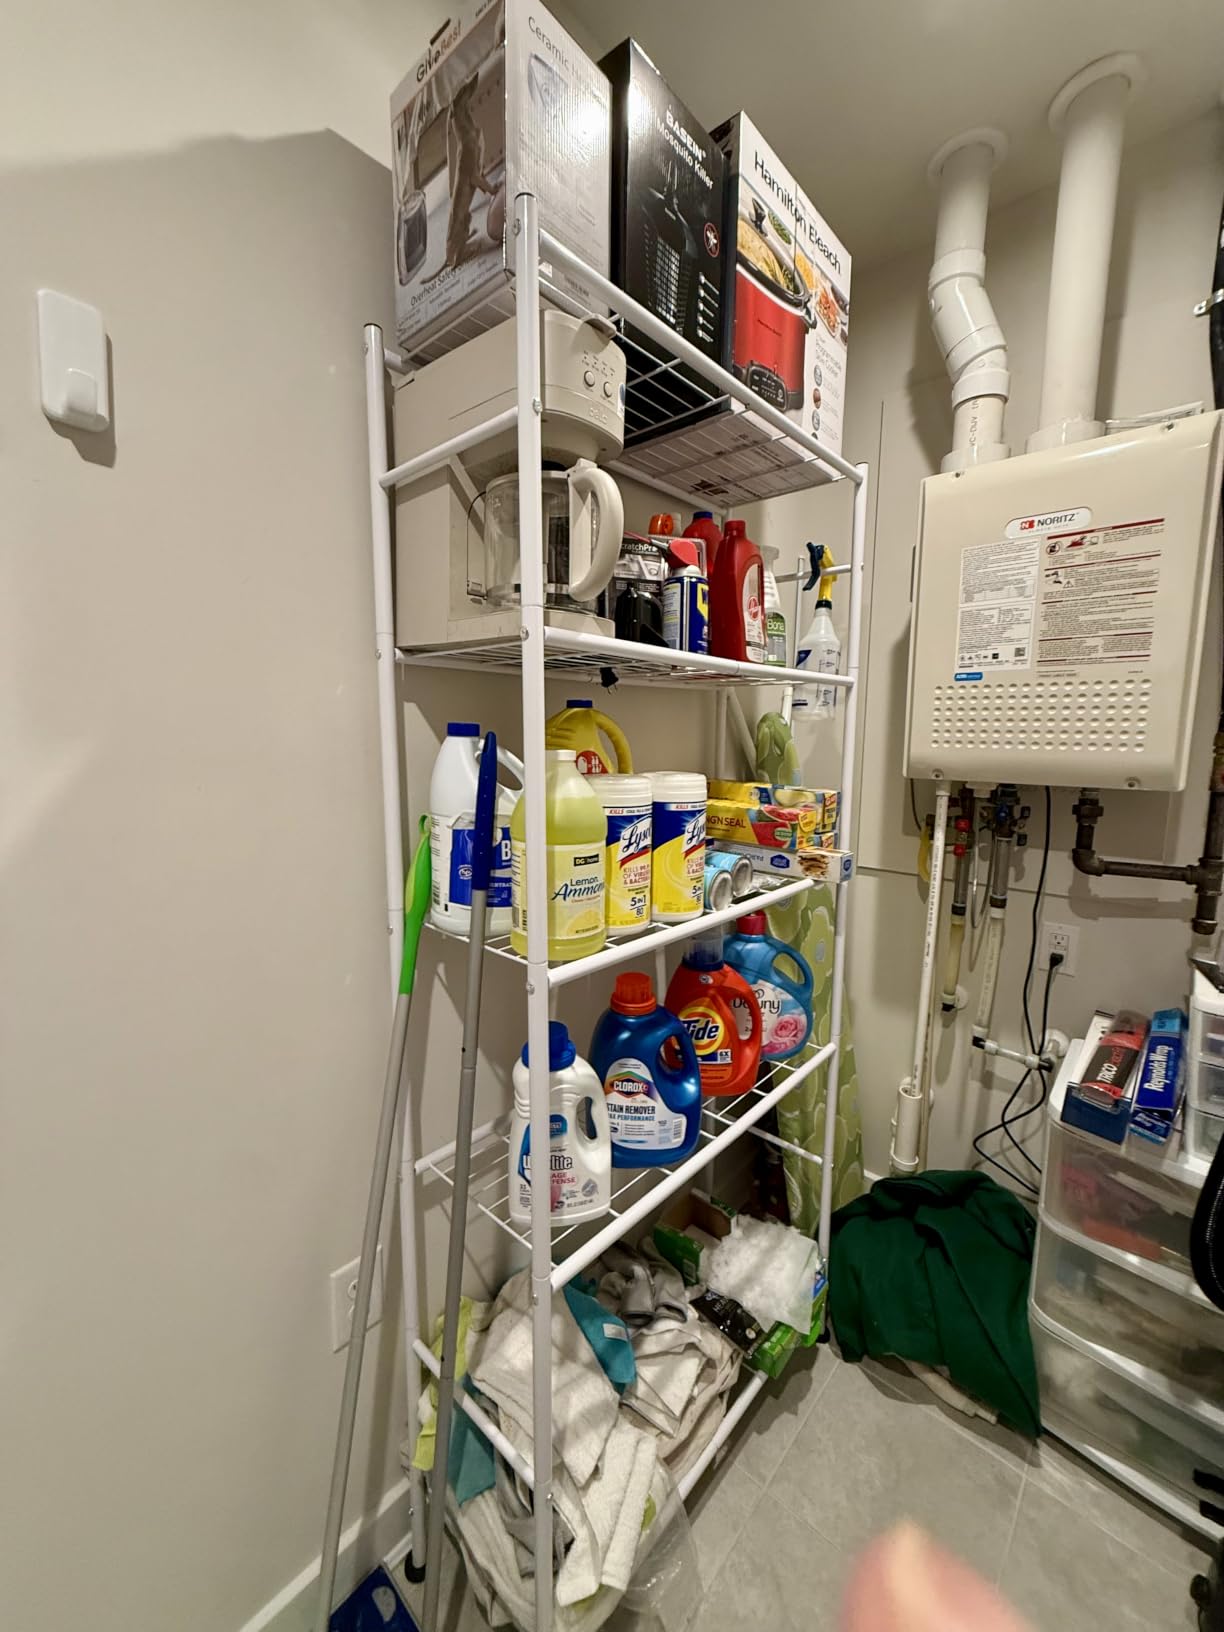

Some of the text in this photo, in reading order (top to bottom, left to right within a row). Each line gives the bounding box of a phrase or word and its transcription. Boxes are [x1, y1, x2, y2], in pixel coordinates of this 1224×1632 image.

[528, 16, 570, 72] Ceramic
[657, 117, 713, 190] Mosquito Killer
[754, 149, 842, 275] Hamilton Beach
[1037, 513, 1075, 528] NORITZ
[767, 618, 784, 630] Bona
[724, 816, 747, 829] SEAL
[570, 876, 600, 887] Lemon
[1096, 1063, 1118, 1084] TRICO
[1143, 1045, 1174, 1092] Reynolds Wrap
[613, 1081, 643, 1094] CLOROX
[625, 1105, 655, 1115] REMOVER
